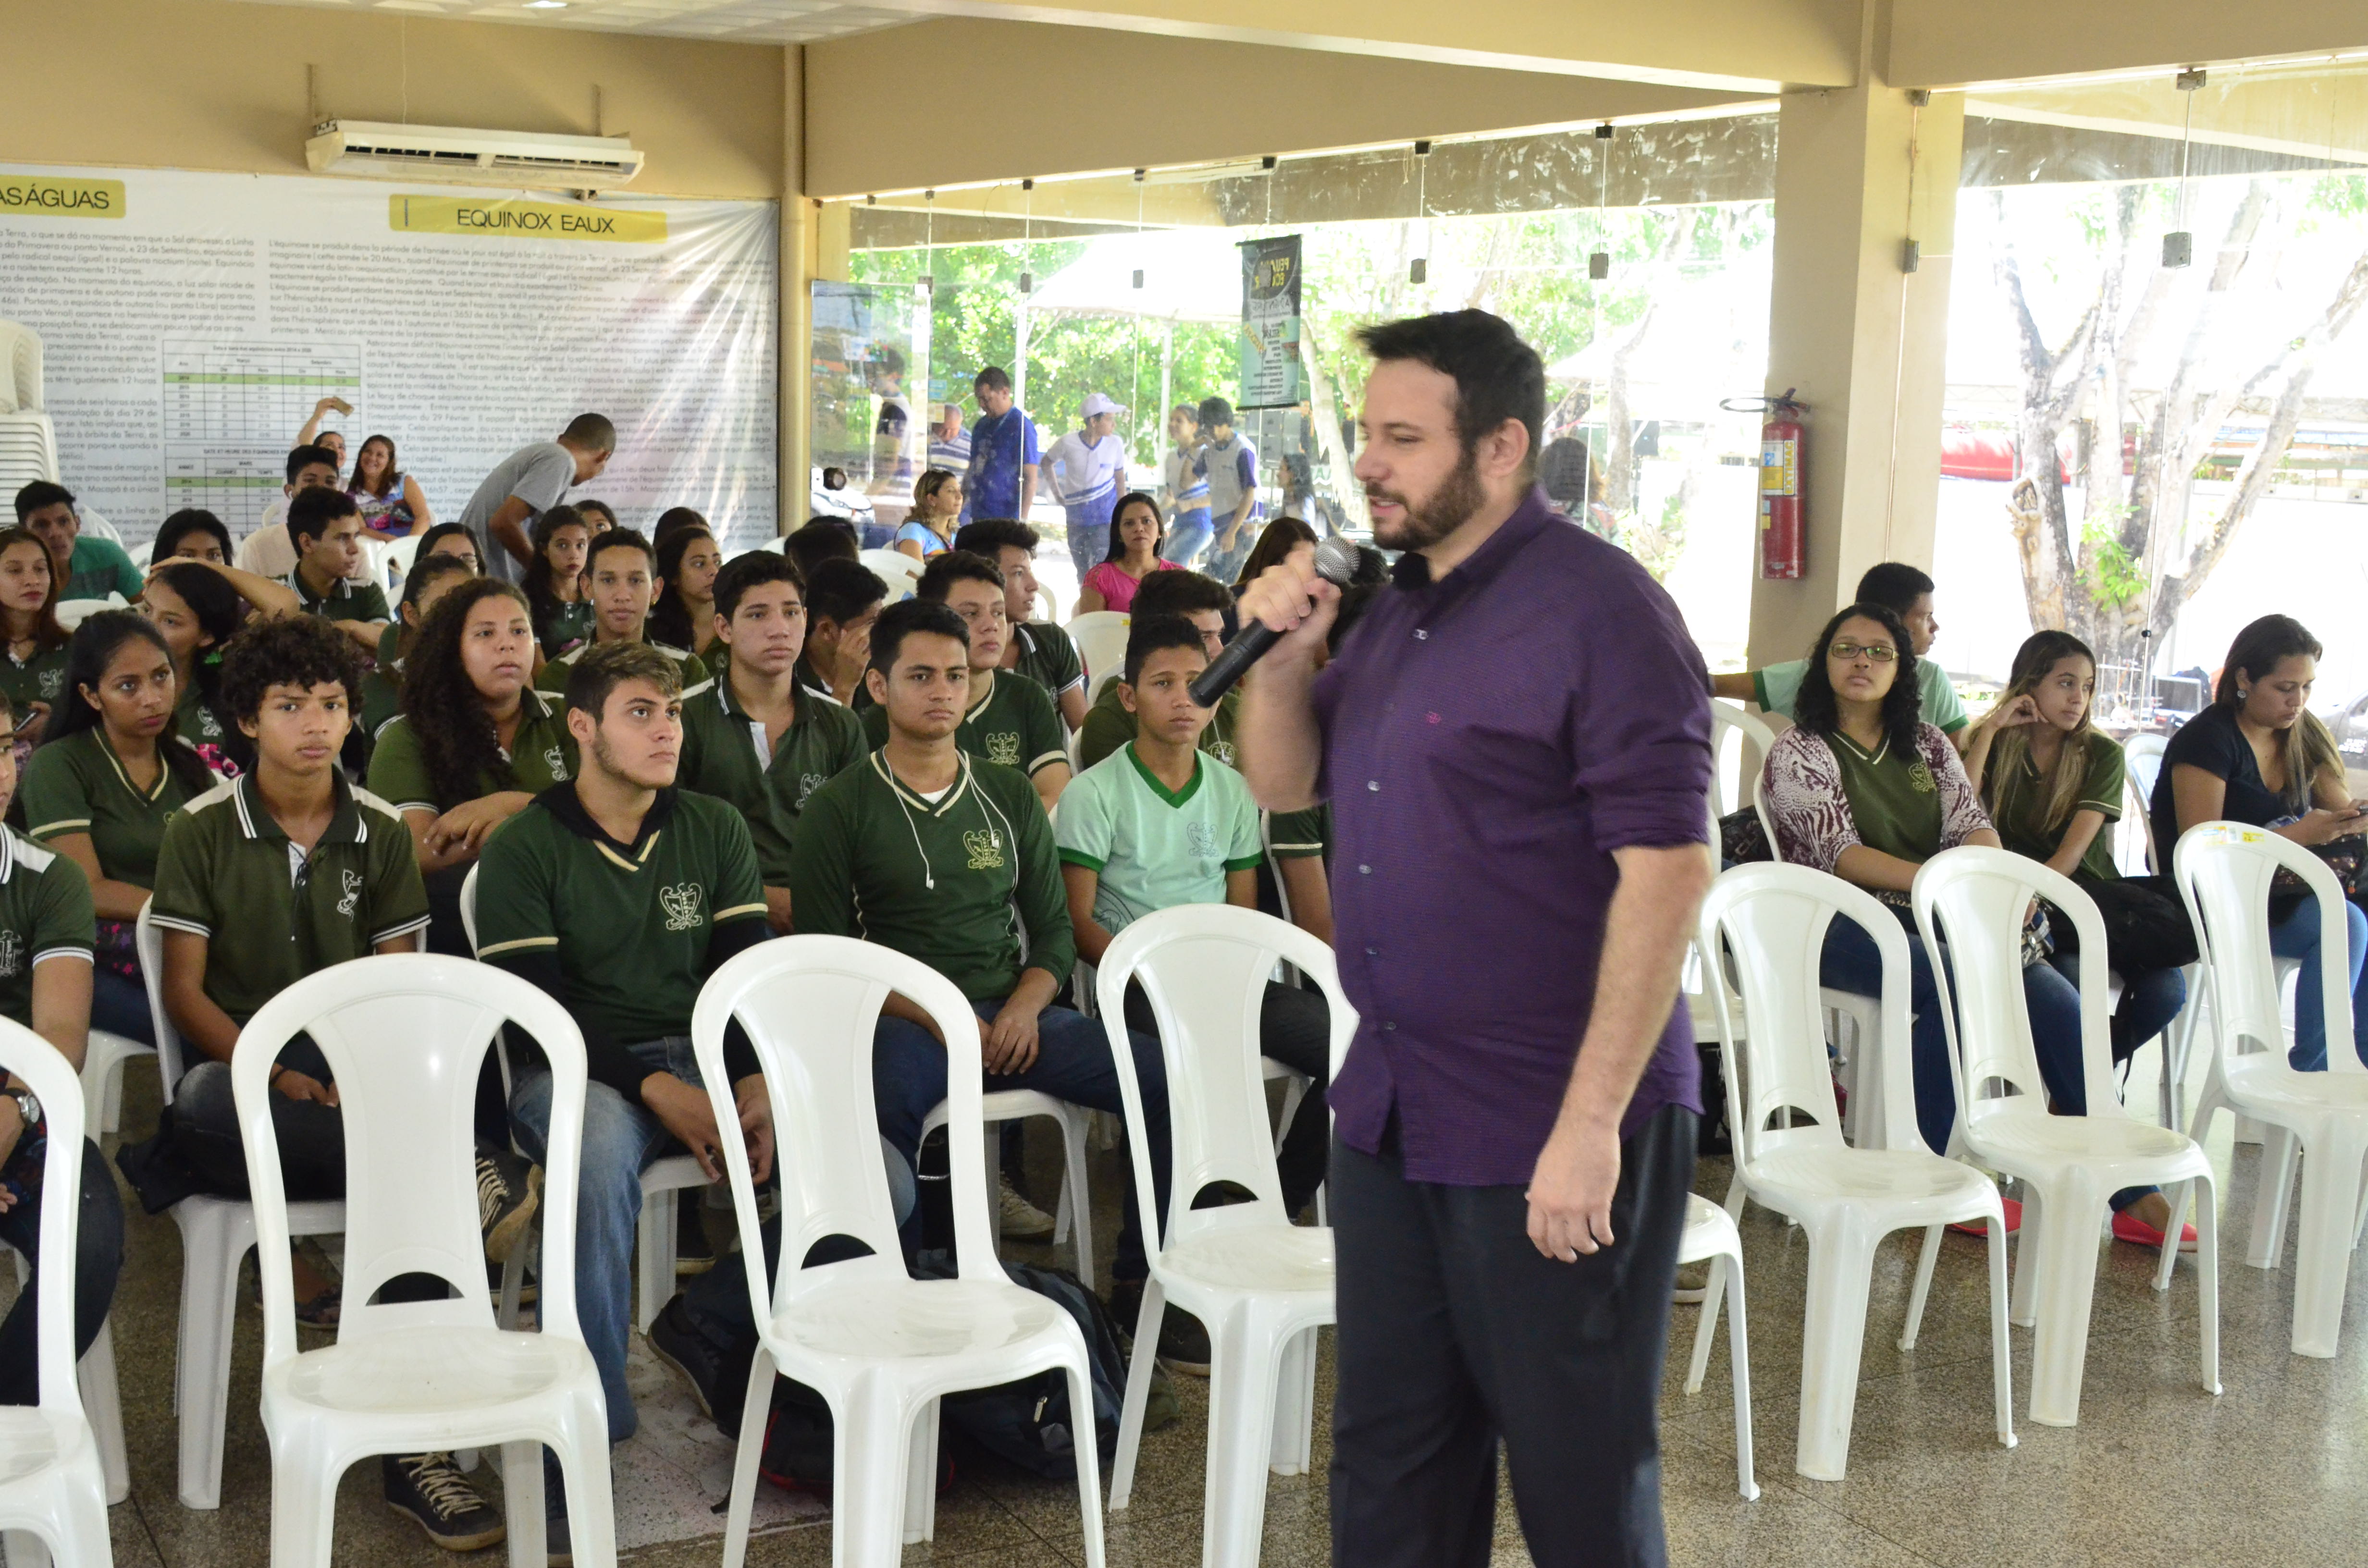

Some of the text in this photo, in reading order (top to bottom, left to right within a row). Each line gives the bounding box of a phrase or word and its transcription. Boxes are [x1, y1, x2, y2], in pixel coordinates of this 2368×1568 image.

[457, 209, 615, 233] EQUINOX EAUX
[136, 245, 148, 253] 23
